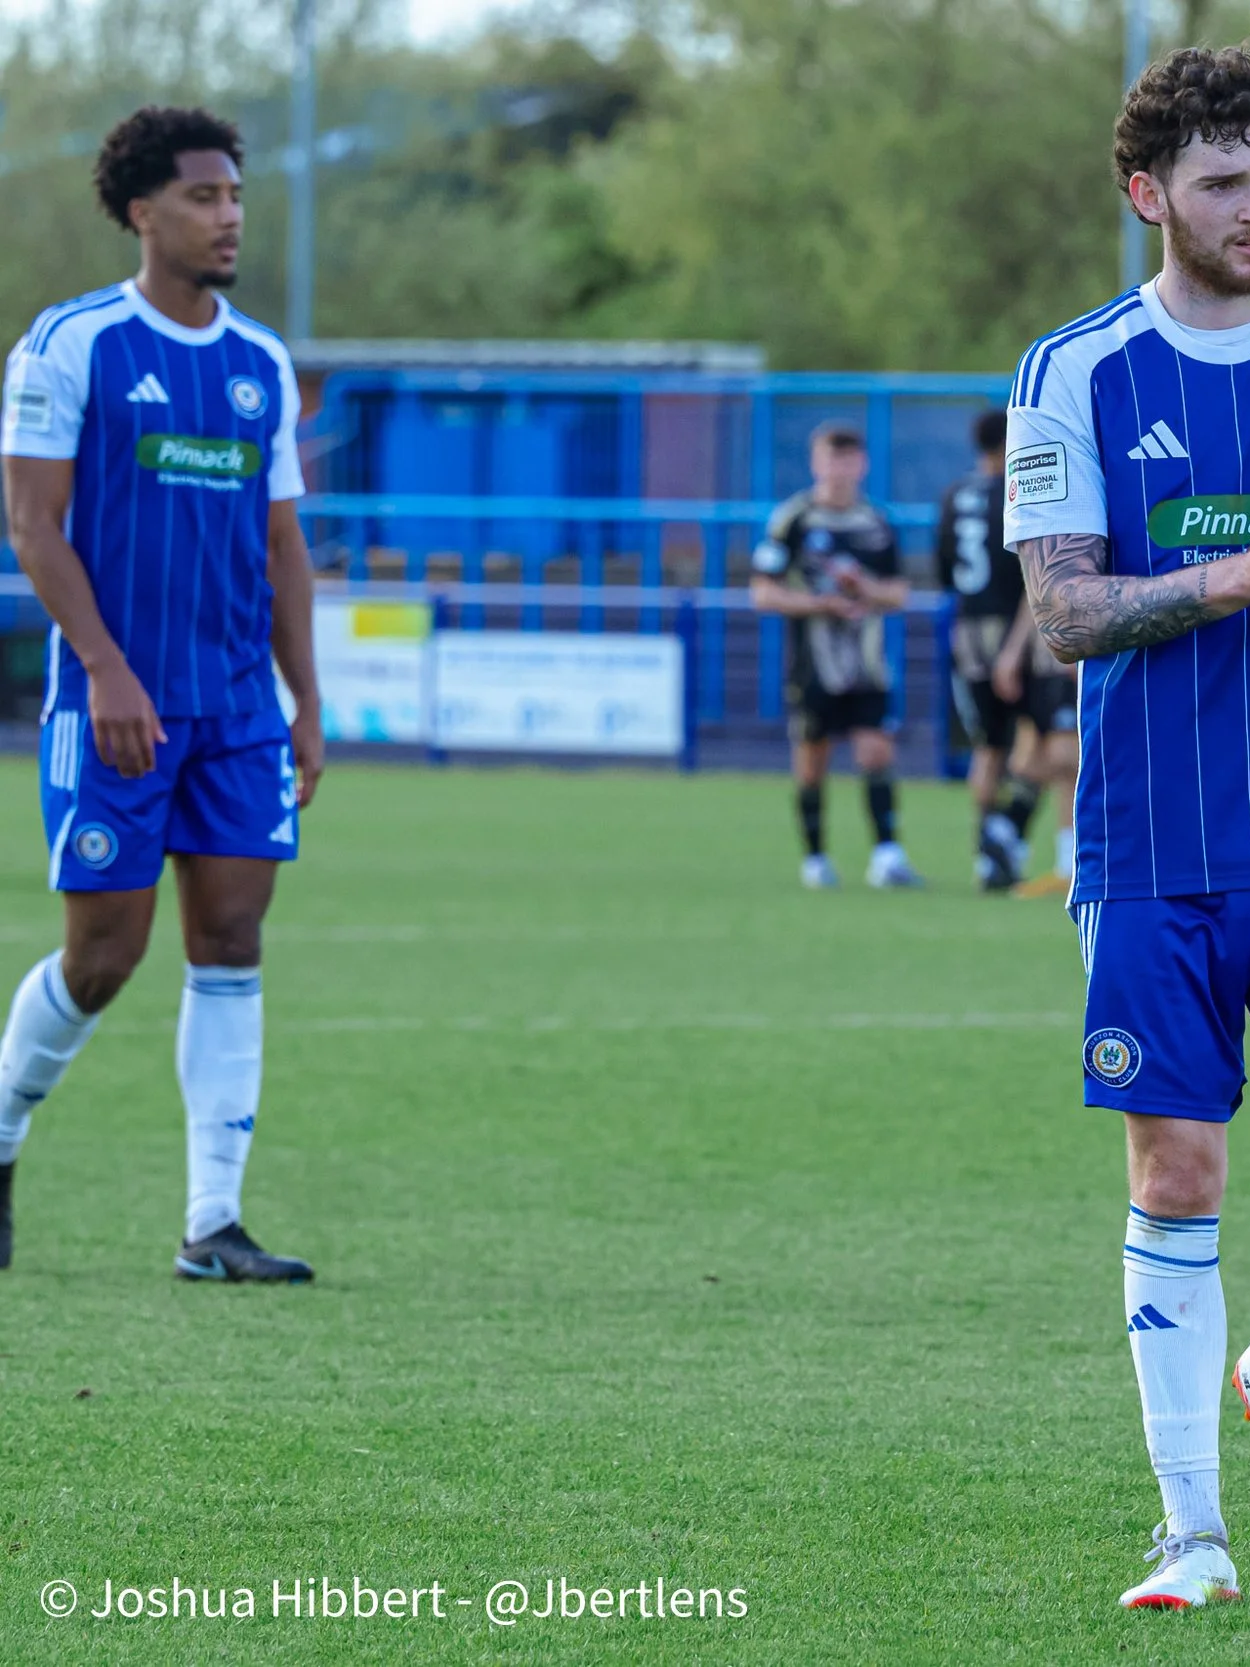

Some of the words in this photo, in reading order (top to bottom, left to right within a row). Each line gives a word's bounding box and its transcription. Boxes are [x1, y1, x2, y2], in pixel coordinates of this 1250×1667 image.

[1018, 474, 1058, 487] NATIONAL
[1023, 482, 1054, 494] LEAGUE
[1087, 1032, 1113, 1051] CURZON
[1116, 1033, 1138, 1056] ASHTON
[1118, 1068, 1134, 1083] CLUB
